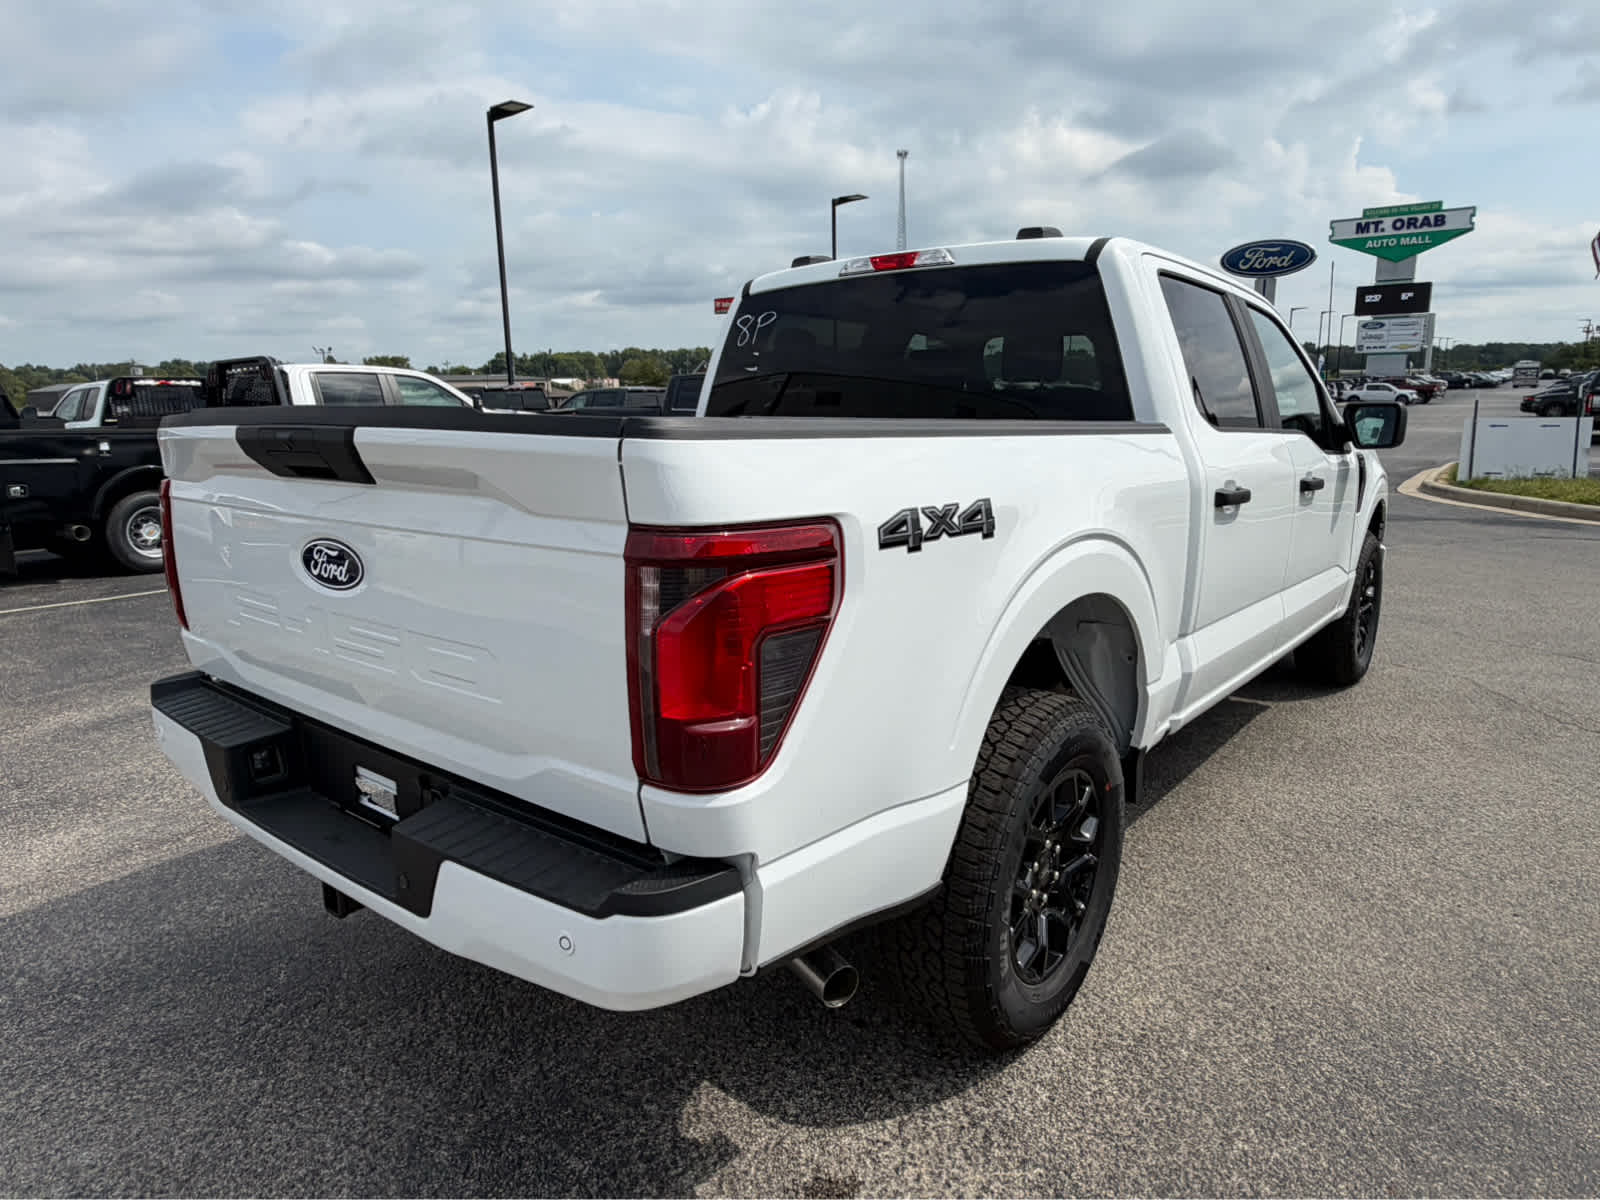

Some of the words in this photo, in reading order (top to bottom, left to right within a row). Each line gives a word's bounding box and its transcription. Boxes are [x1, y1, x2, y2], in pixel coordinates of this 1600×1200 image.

[1355, 220, 1385, 235] MT.
[1391, 214, 1447, 231] ORAB
[1365, 238, 1397, 249] AUTO
[1400, 235, 1432, 246] MALL
[1239, 246, 1295, 270] Ford
[310, 545, 349, 582] Ford
